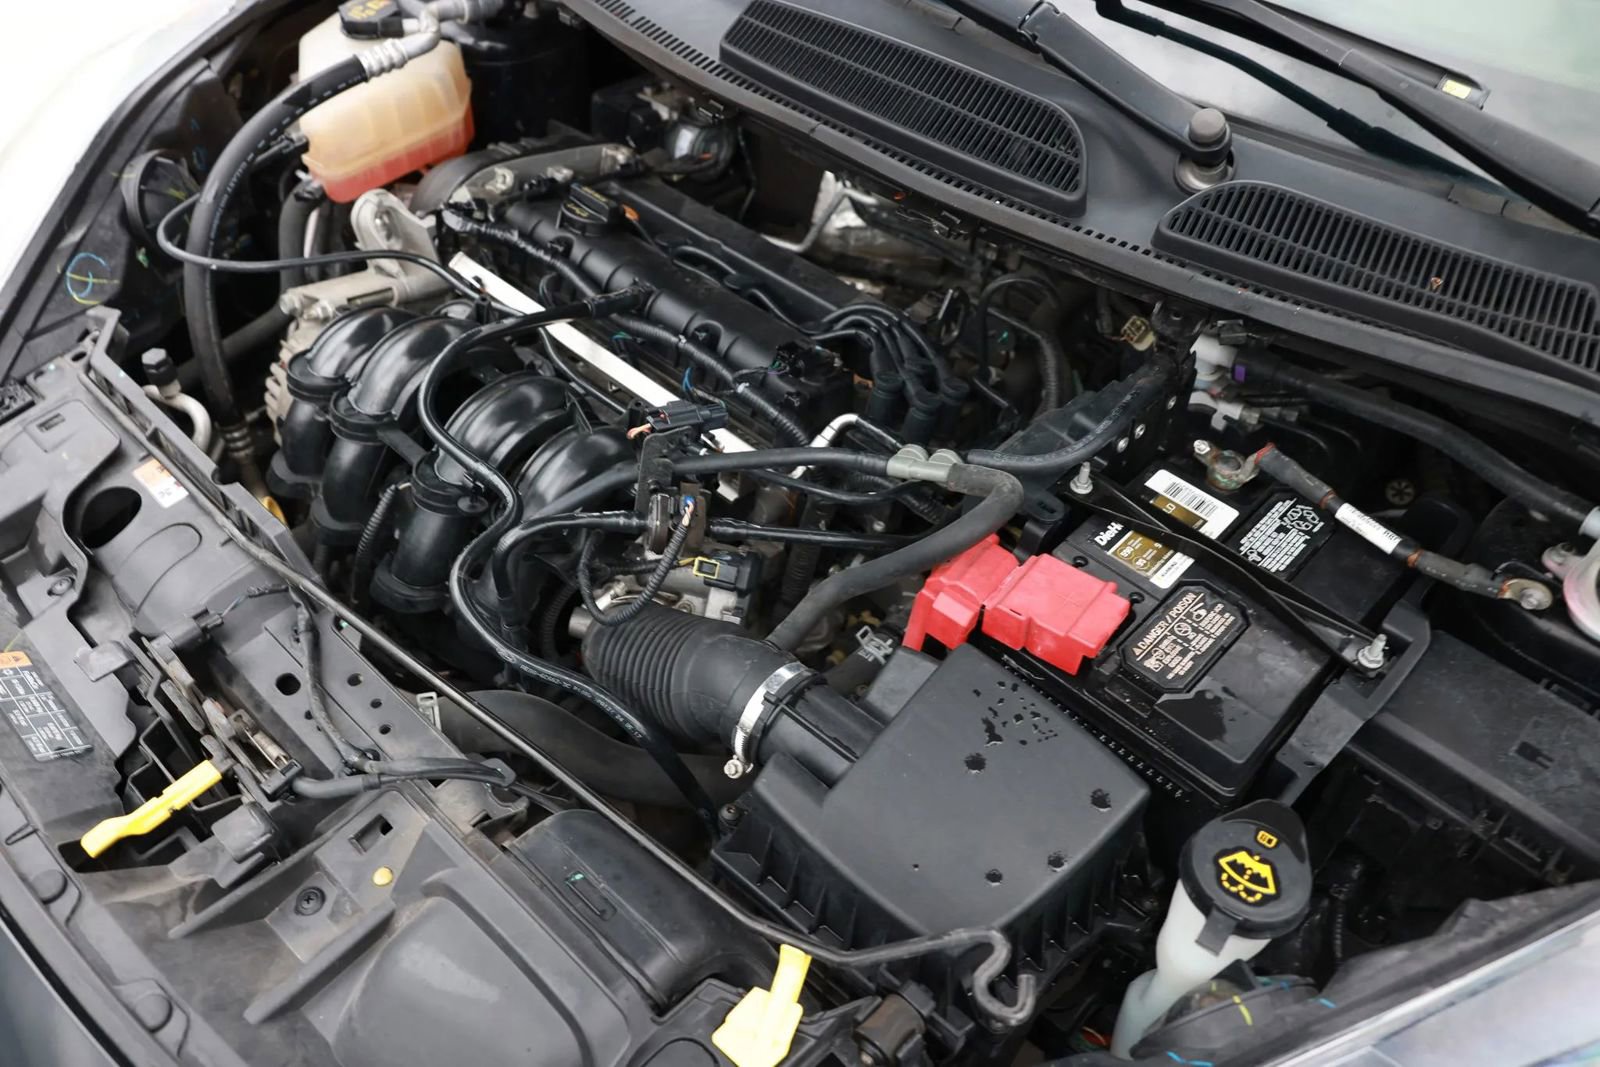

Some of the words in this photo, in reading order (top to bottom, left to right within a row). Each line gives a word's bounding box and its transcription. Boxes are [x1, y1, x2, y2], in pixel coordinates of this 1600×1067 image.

[1094, 521, 1124, 546] DieH
[1137, 620, 1169, 650] DANGER
[1169, 592, 1197, 618] POISON
